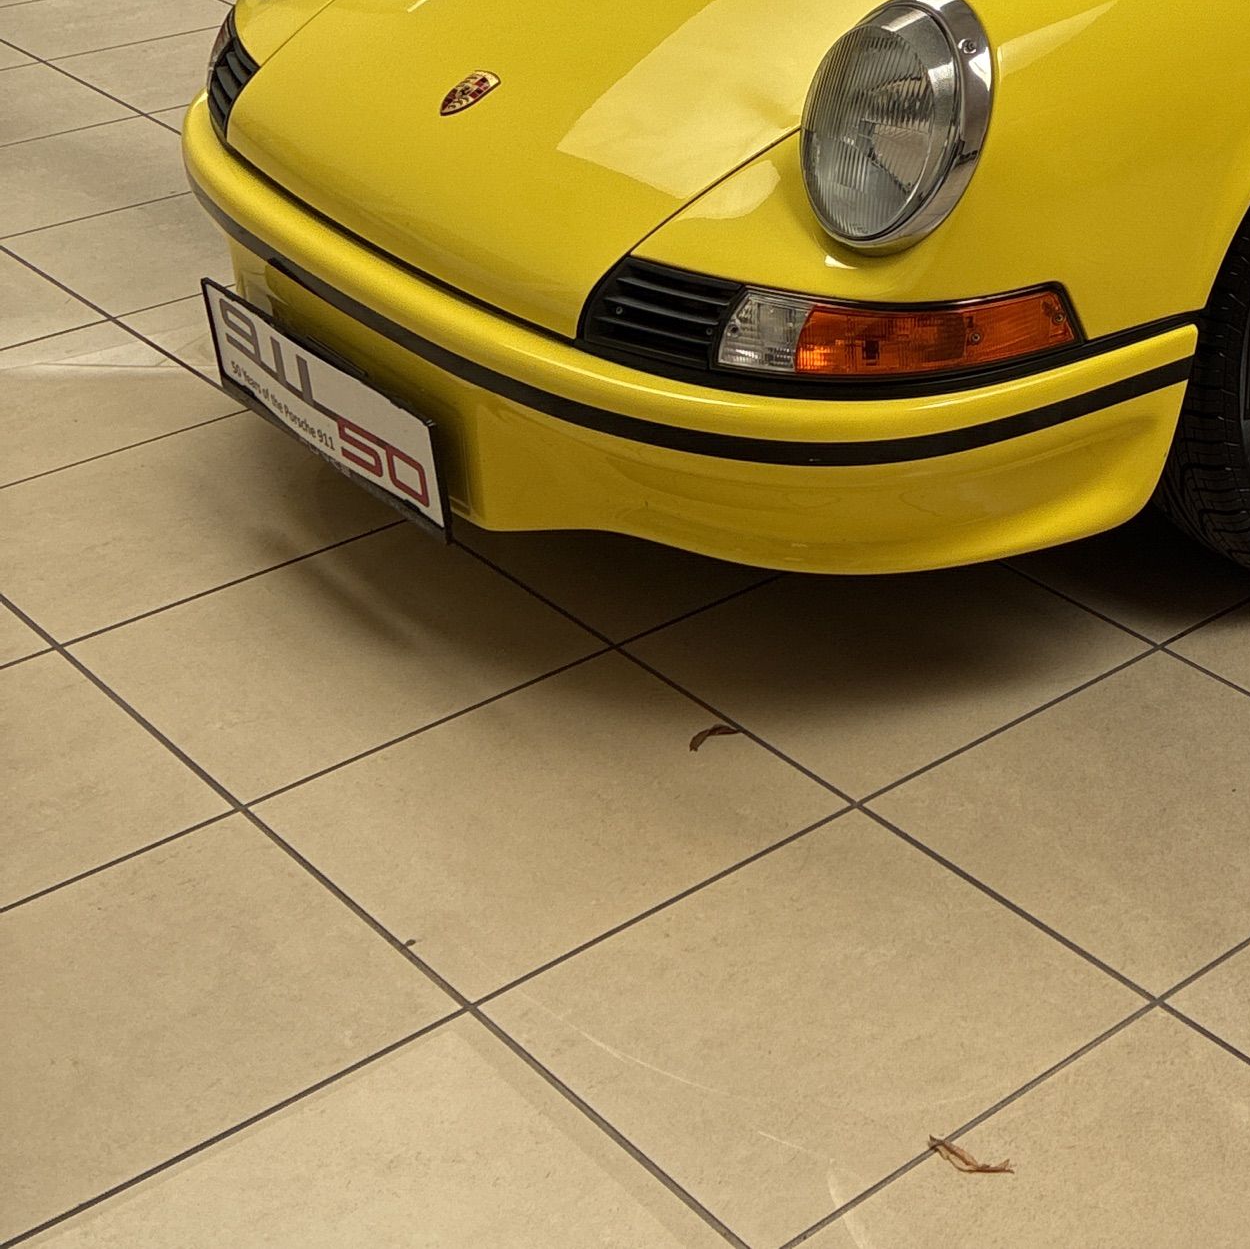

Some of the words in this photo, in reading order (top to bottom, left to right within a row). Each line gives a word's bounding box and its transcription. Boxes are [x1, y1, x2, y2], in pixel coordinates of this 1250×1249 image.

[219, 298, 319, 406] 911
[337, 415, 430, 508] 50
[231, 360, 241, 378] 50
[260, 387, 270, 402] of
[271, 393, 283, 414] the
[284, 401, 316, 438] Porsche
[317, 429, 335, 451] 911
